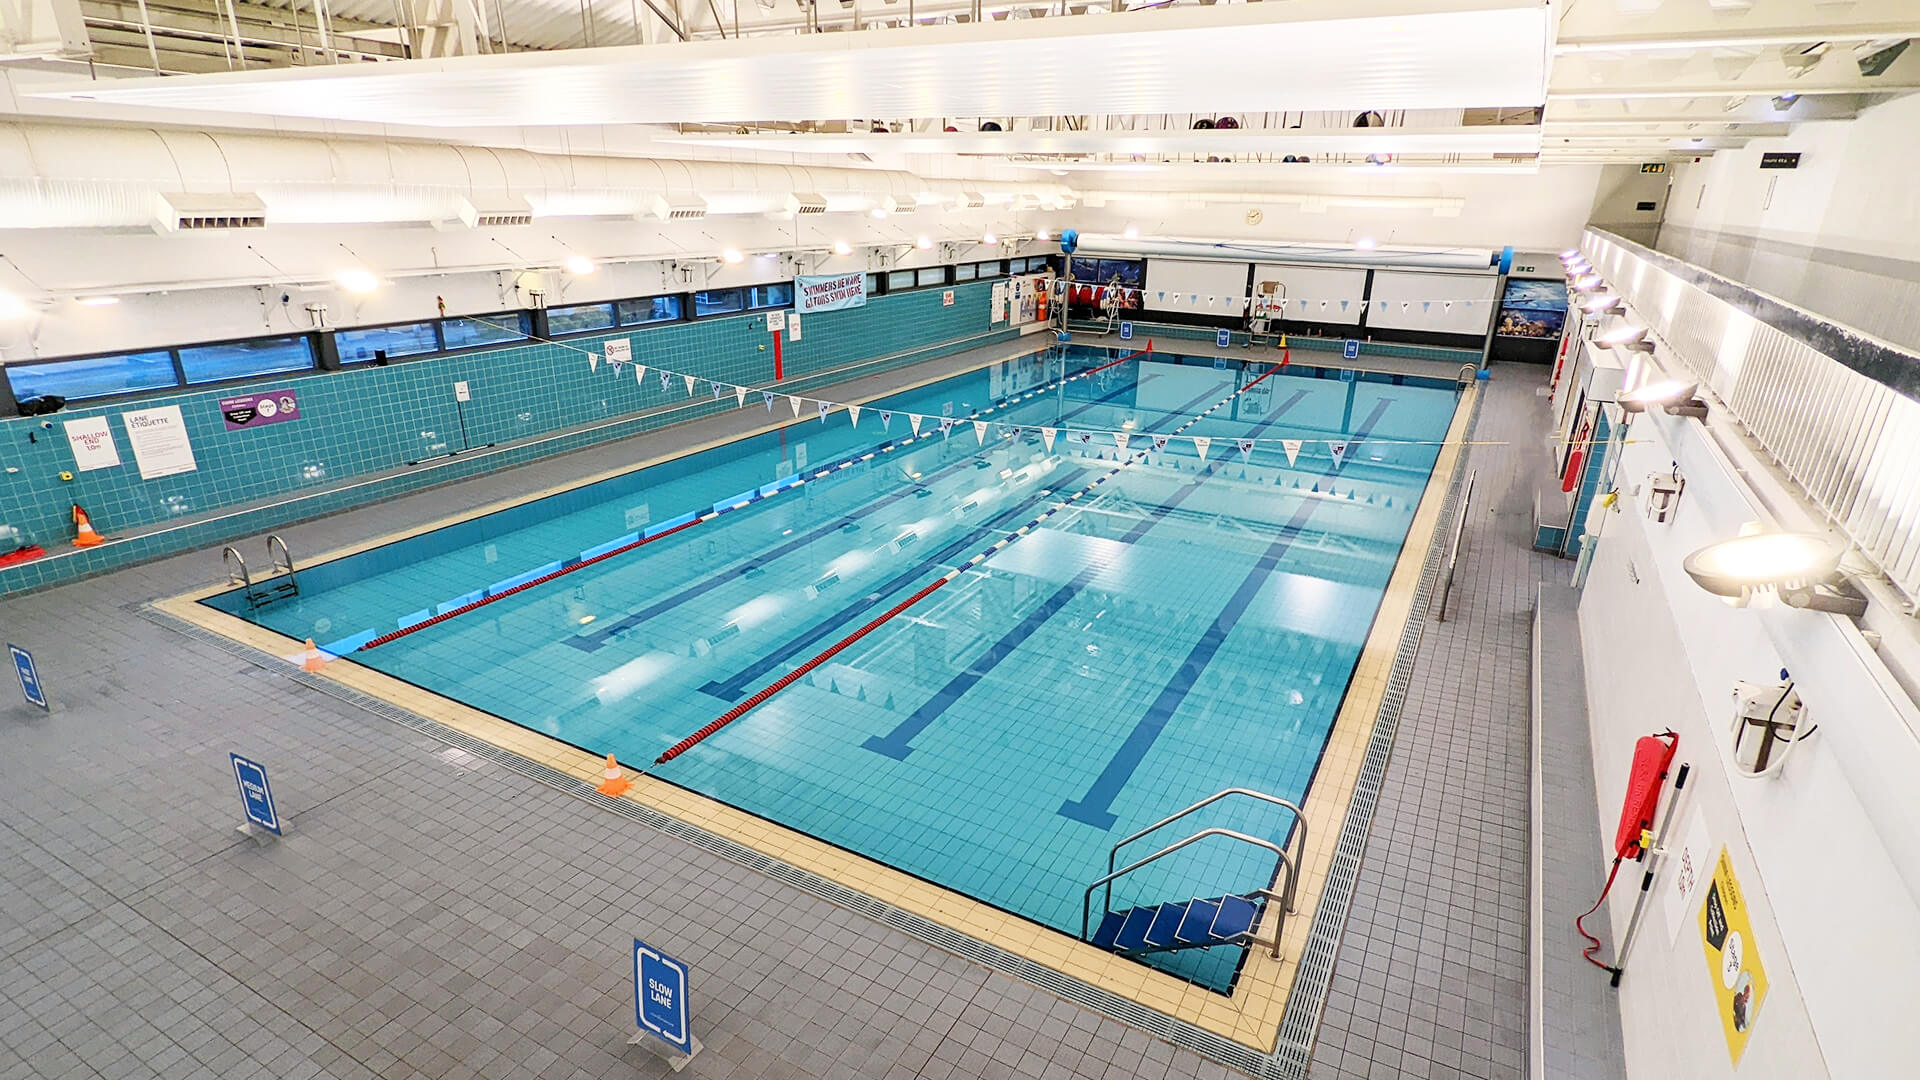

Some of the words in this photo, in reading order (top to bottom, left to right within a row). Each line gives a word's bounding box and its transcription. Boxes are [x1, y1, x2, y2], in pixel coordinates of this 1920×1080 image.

[804, 281, 837, 296] SWIMMERS
[837, 274, 861, 288] BEWARE
[805, 293, 830, 308] GATORS
[830, 289, 847, 302] SWIM
[847, 285, 861, 297] HERE
[130, 415, 148, 423] LANE
[131, 417, 168, 429] ETIQUETTE
[72, 431, 108, 442] SHALLOW
[84, 438, 100, 446] END
[243, 780, 264, 795] MEDIUM
[248, 789, 264, 803] LANE
[648, 978, 673, 998] SLOW
[650, 990, 672, 1010] LANE
